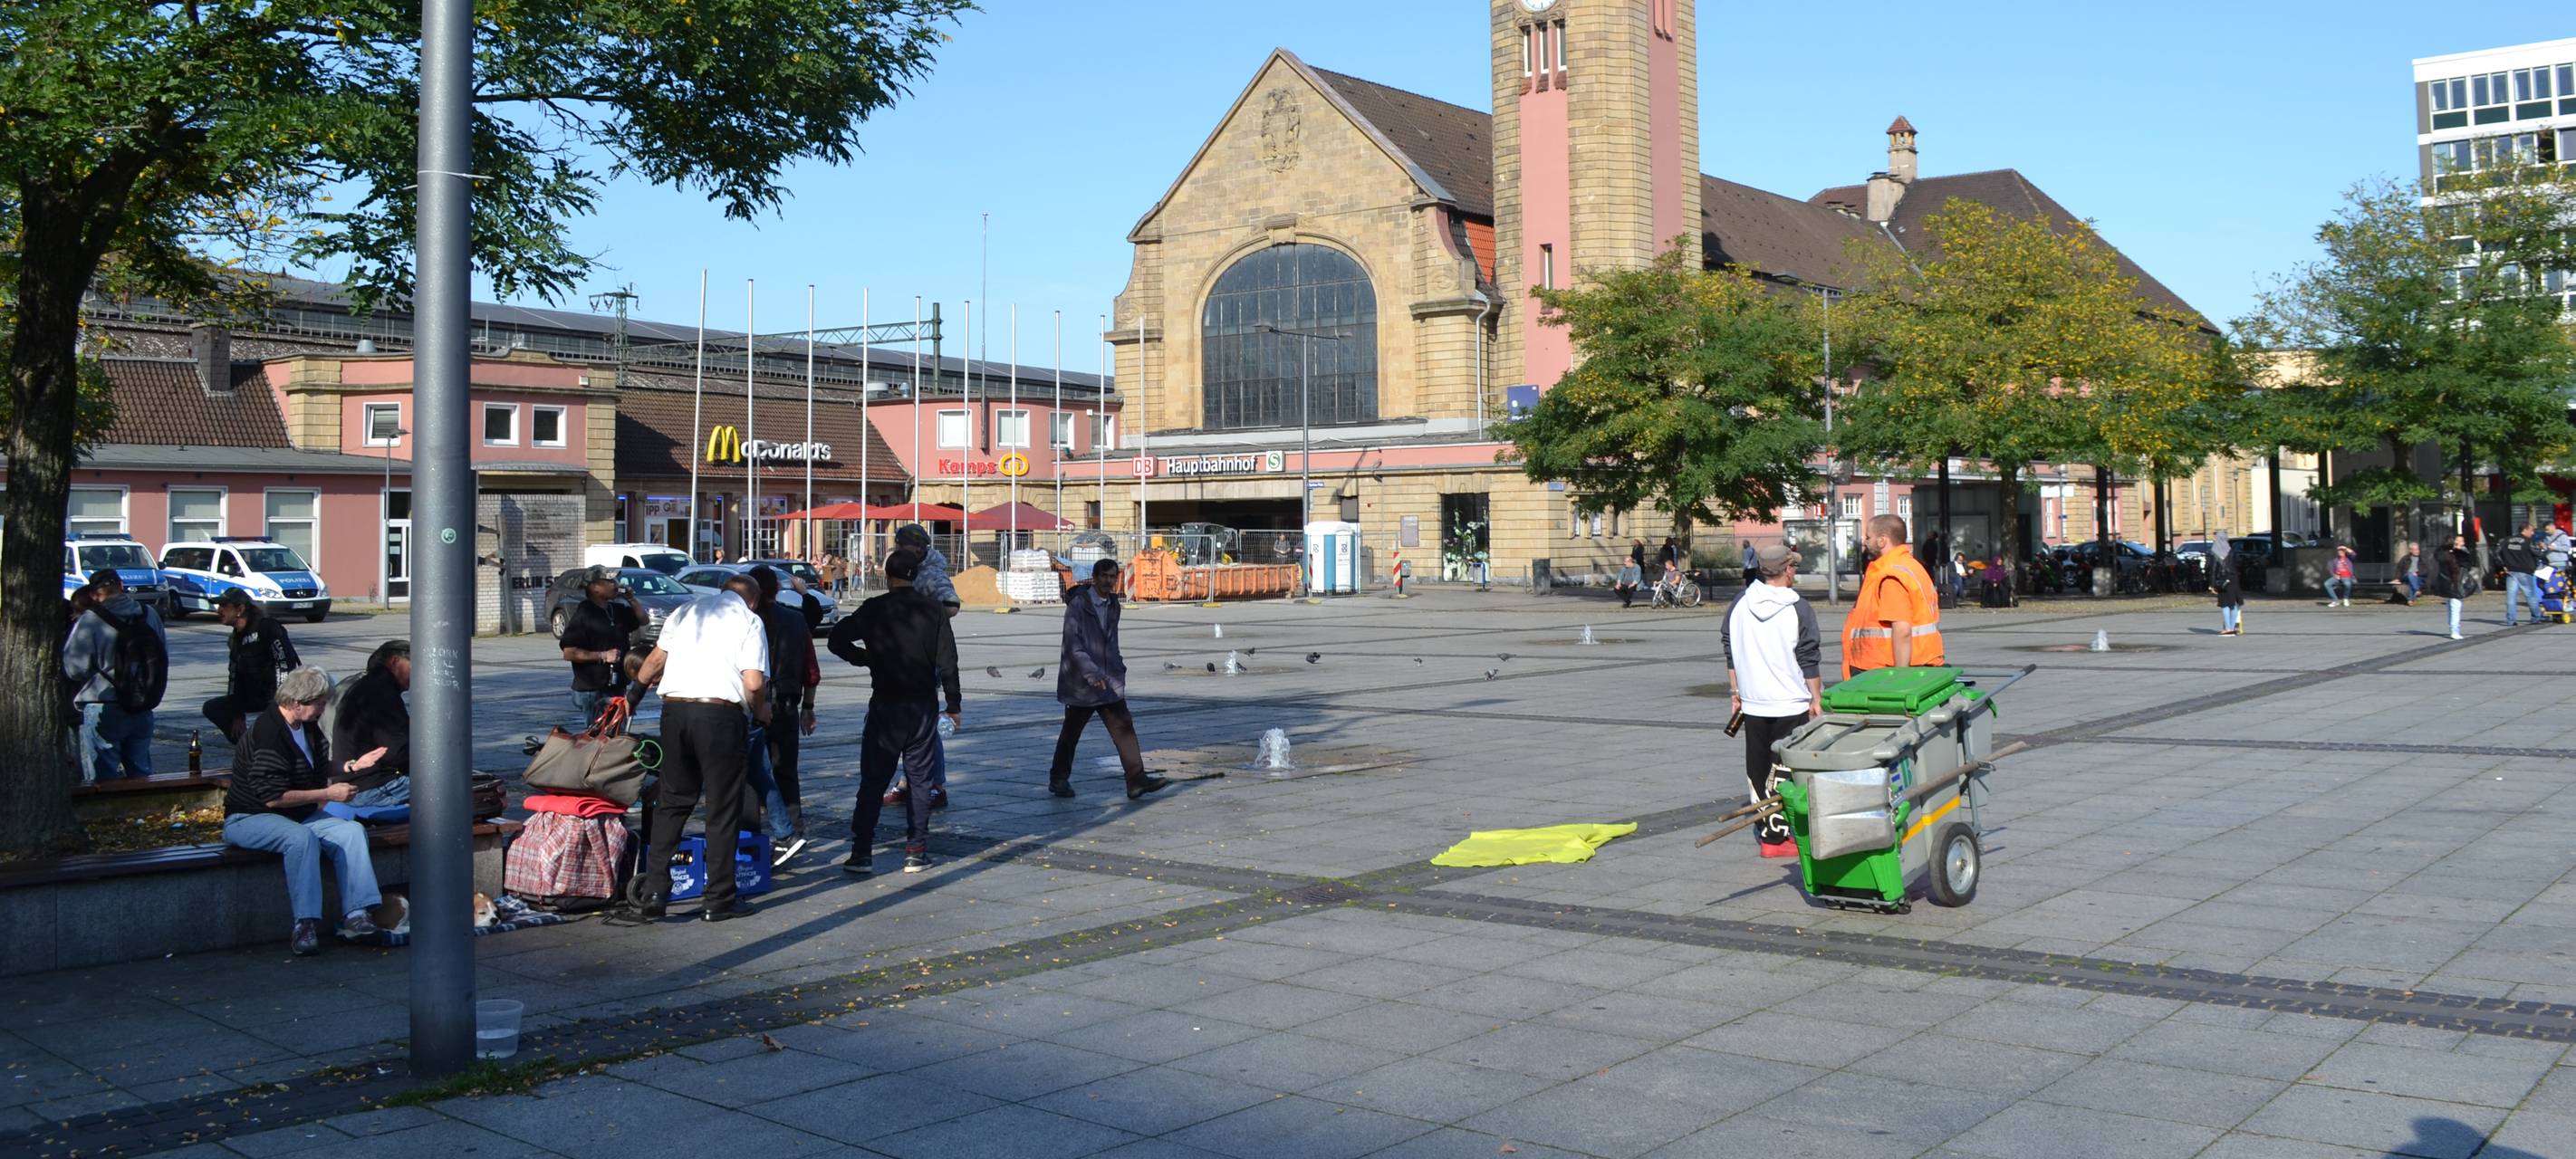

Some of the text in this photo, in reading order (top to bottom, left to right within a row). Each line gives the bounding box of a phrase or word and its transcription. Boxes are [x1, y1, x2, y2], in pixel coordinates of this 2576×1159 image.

[706, 425, 831, 463] McDonald's
[938, 458, 996, 476] Kamps
[1134, 453, 1280, 474] DB Hauptbahnhof S
